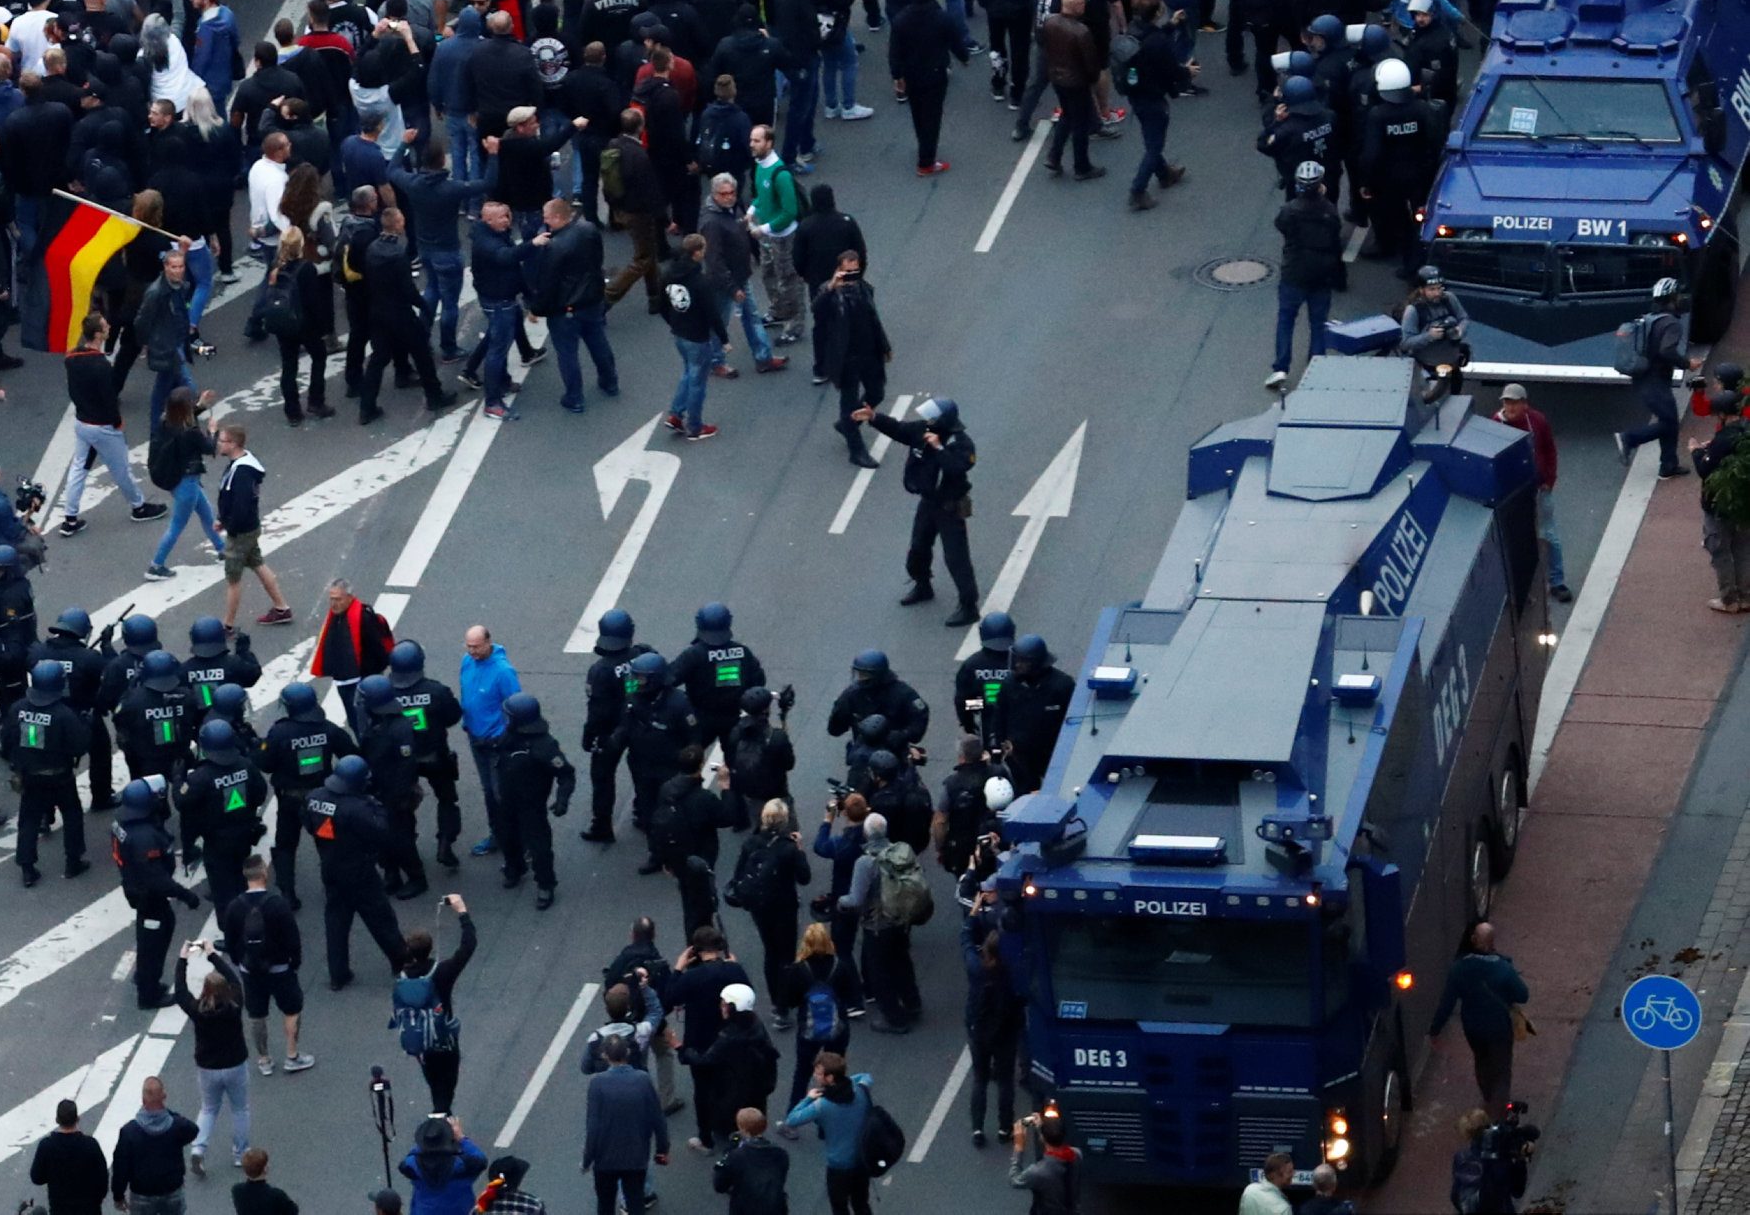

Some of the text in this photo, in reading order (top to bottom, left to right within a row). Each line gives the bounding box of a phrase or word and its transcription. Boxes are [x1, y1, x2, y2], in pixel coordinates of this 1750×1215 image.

[1387, 121, 1418, 136] POLIZEI
[1493, 215, 1627, 237] POLIZEI BW 1
[1373, 509, 1428, 617] POLIZEI
[708, 646, 745, 662] POLIZEI
[187, 668, 225, 682] POLIZEI
[975, 669, 1010, 680] POLIZE
[1433, 643, 1470, 766] DEG 3
[18, 710, 52, 726] POLIZEI
[291, 733, 328, 751] POLIZEI
[215, 769, 249, 790] POLIZEI
[308, 798, 337, 816] POLIZEI
[1133, 899, 1207, 916] POLIZEI
[1074, 1047, 1128, 1069] DEG 3
